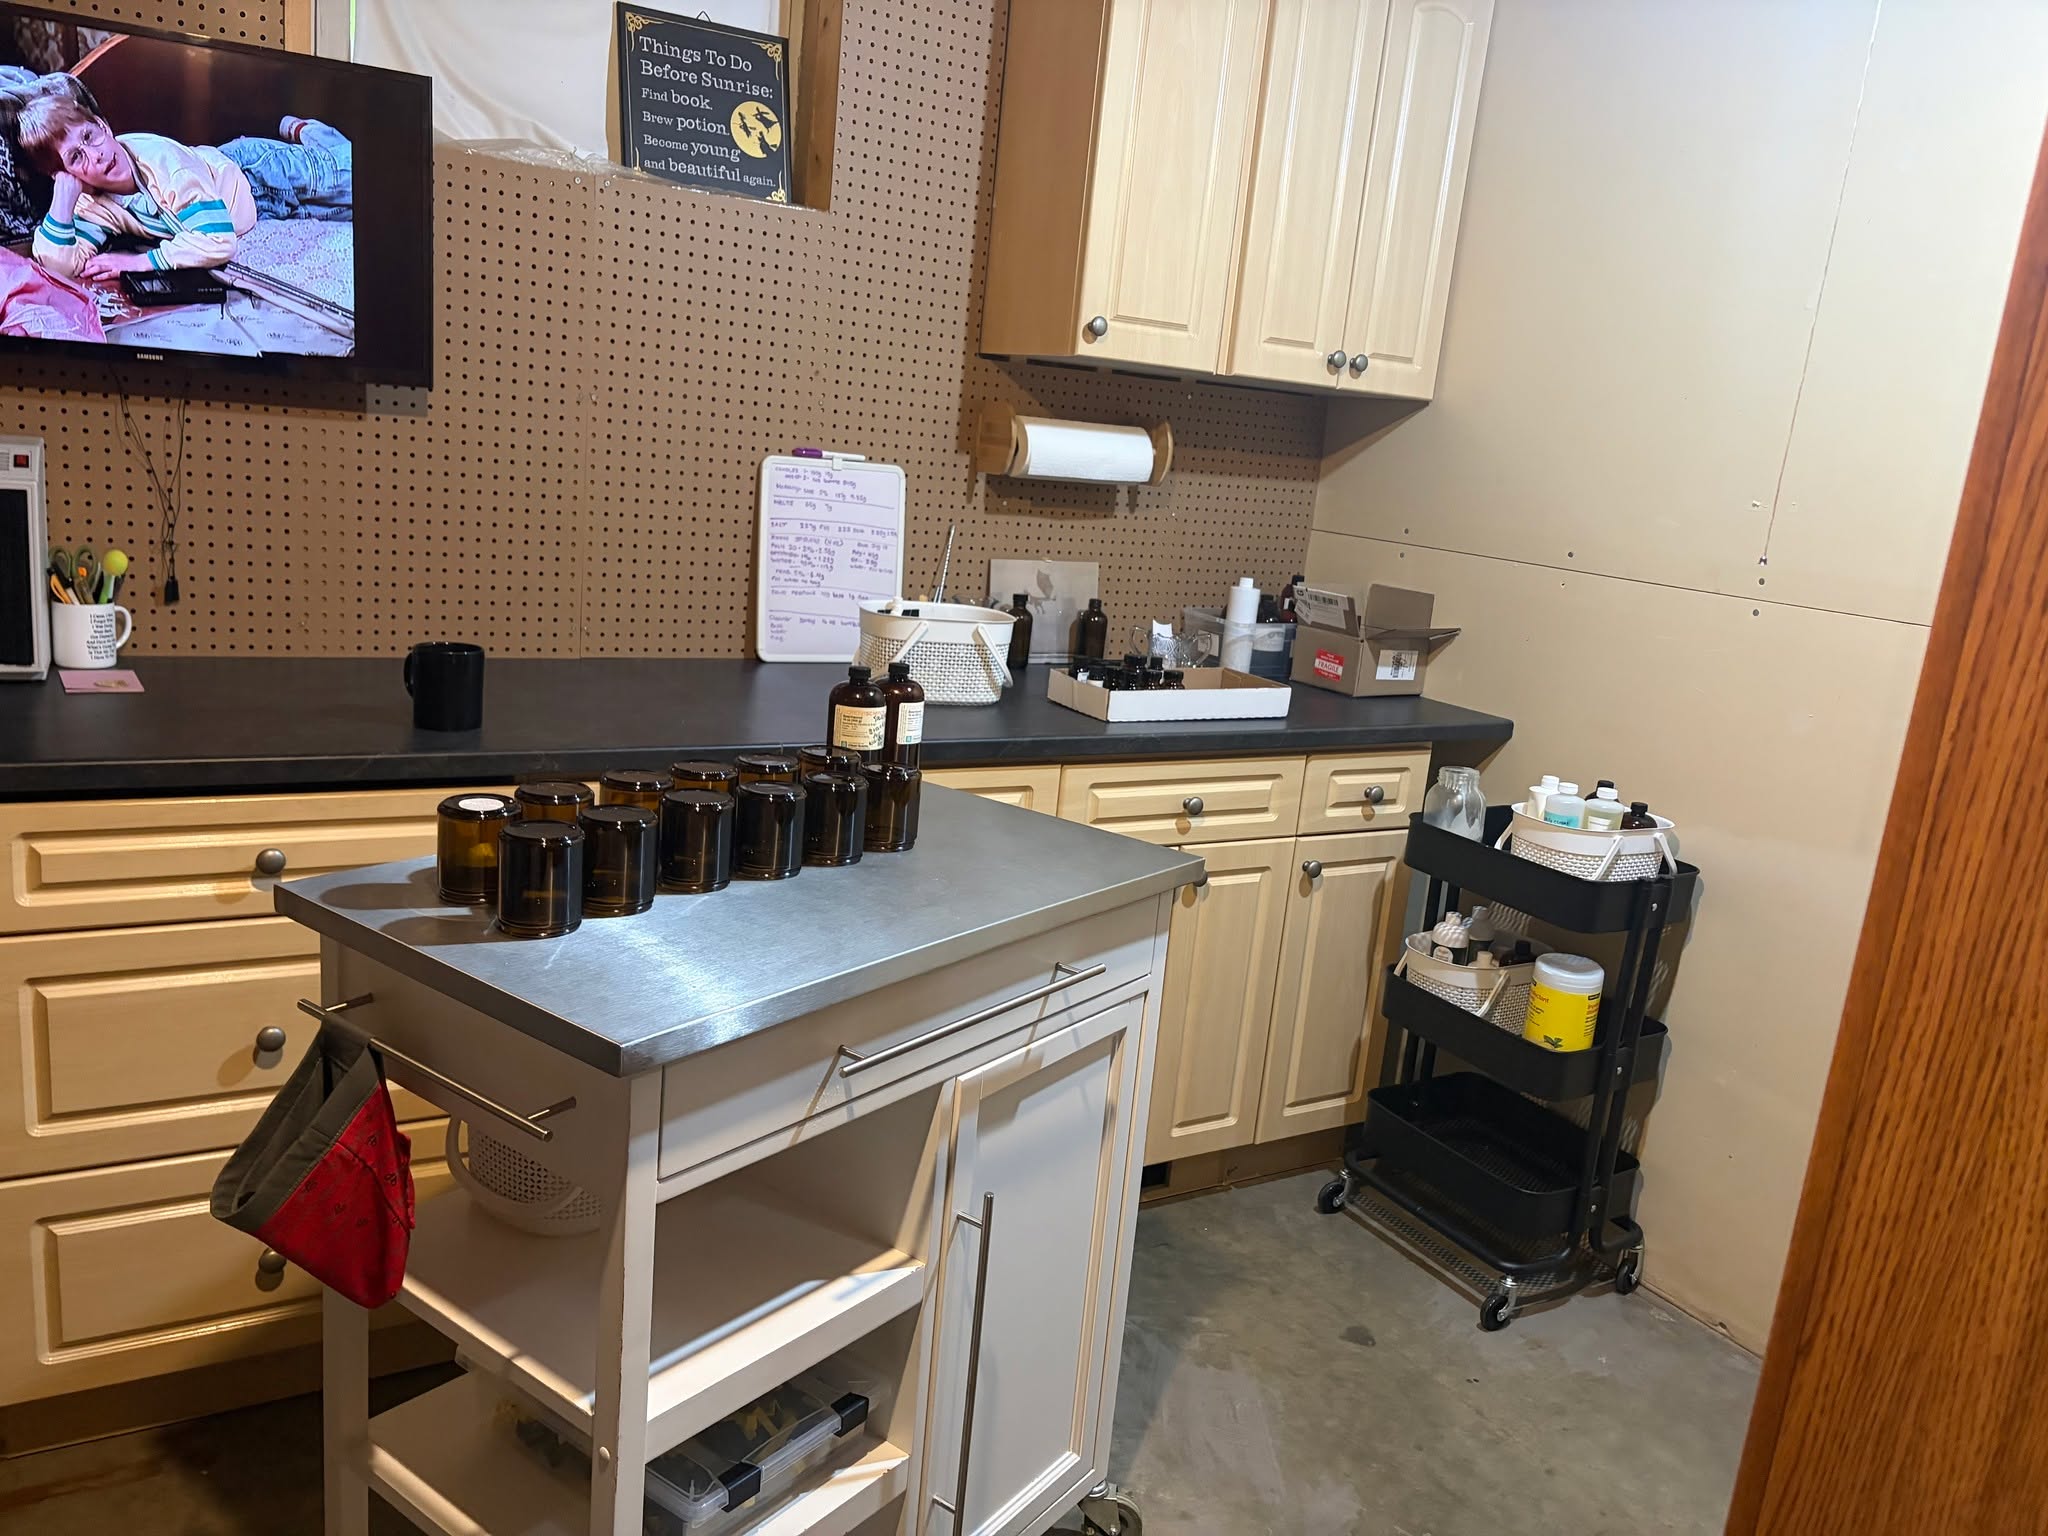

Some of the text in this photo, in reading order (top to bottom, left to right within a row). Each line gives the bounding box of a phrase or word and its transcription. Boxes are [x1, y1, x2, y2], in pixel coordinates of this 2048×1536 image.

[639, 36, 752, 72] Things To Do
[640, 60, 773, 98] Before Sunrise:
[642, 88, 713, 110] Find book.
[642, 111, 730, 136] Brew potion.
[643, 134, 741, 162] Become young
[644, 158, 776, 187] and beautiful again.
[1318, 660, 1339, 673] FRAGILE
